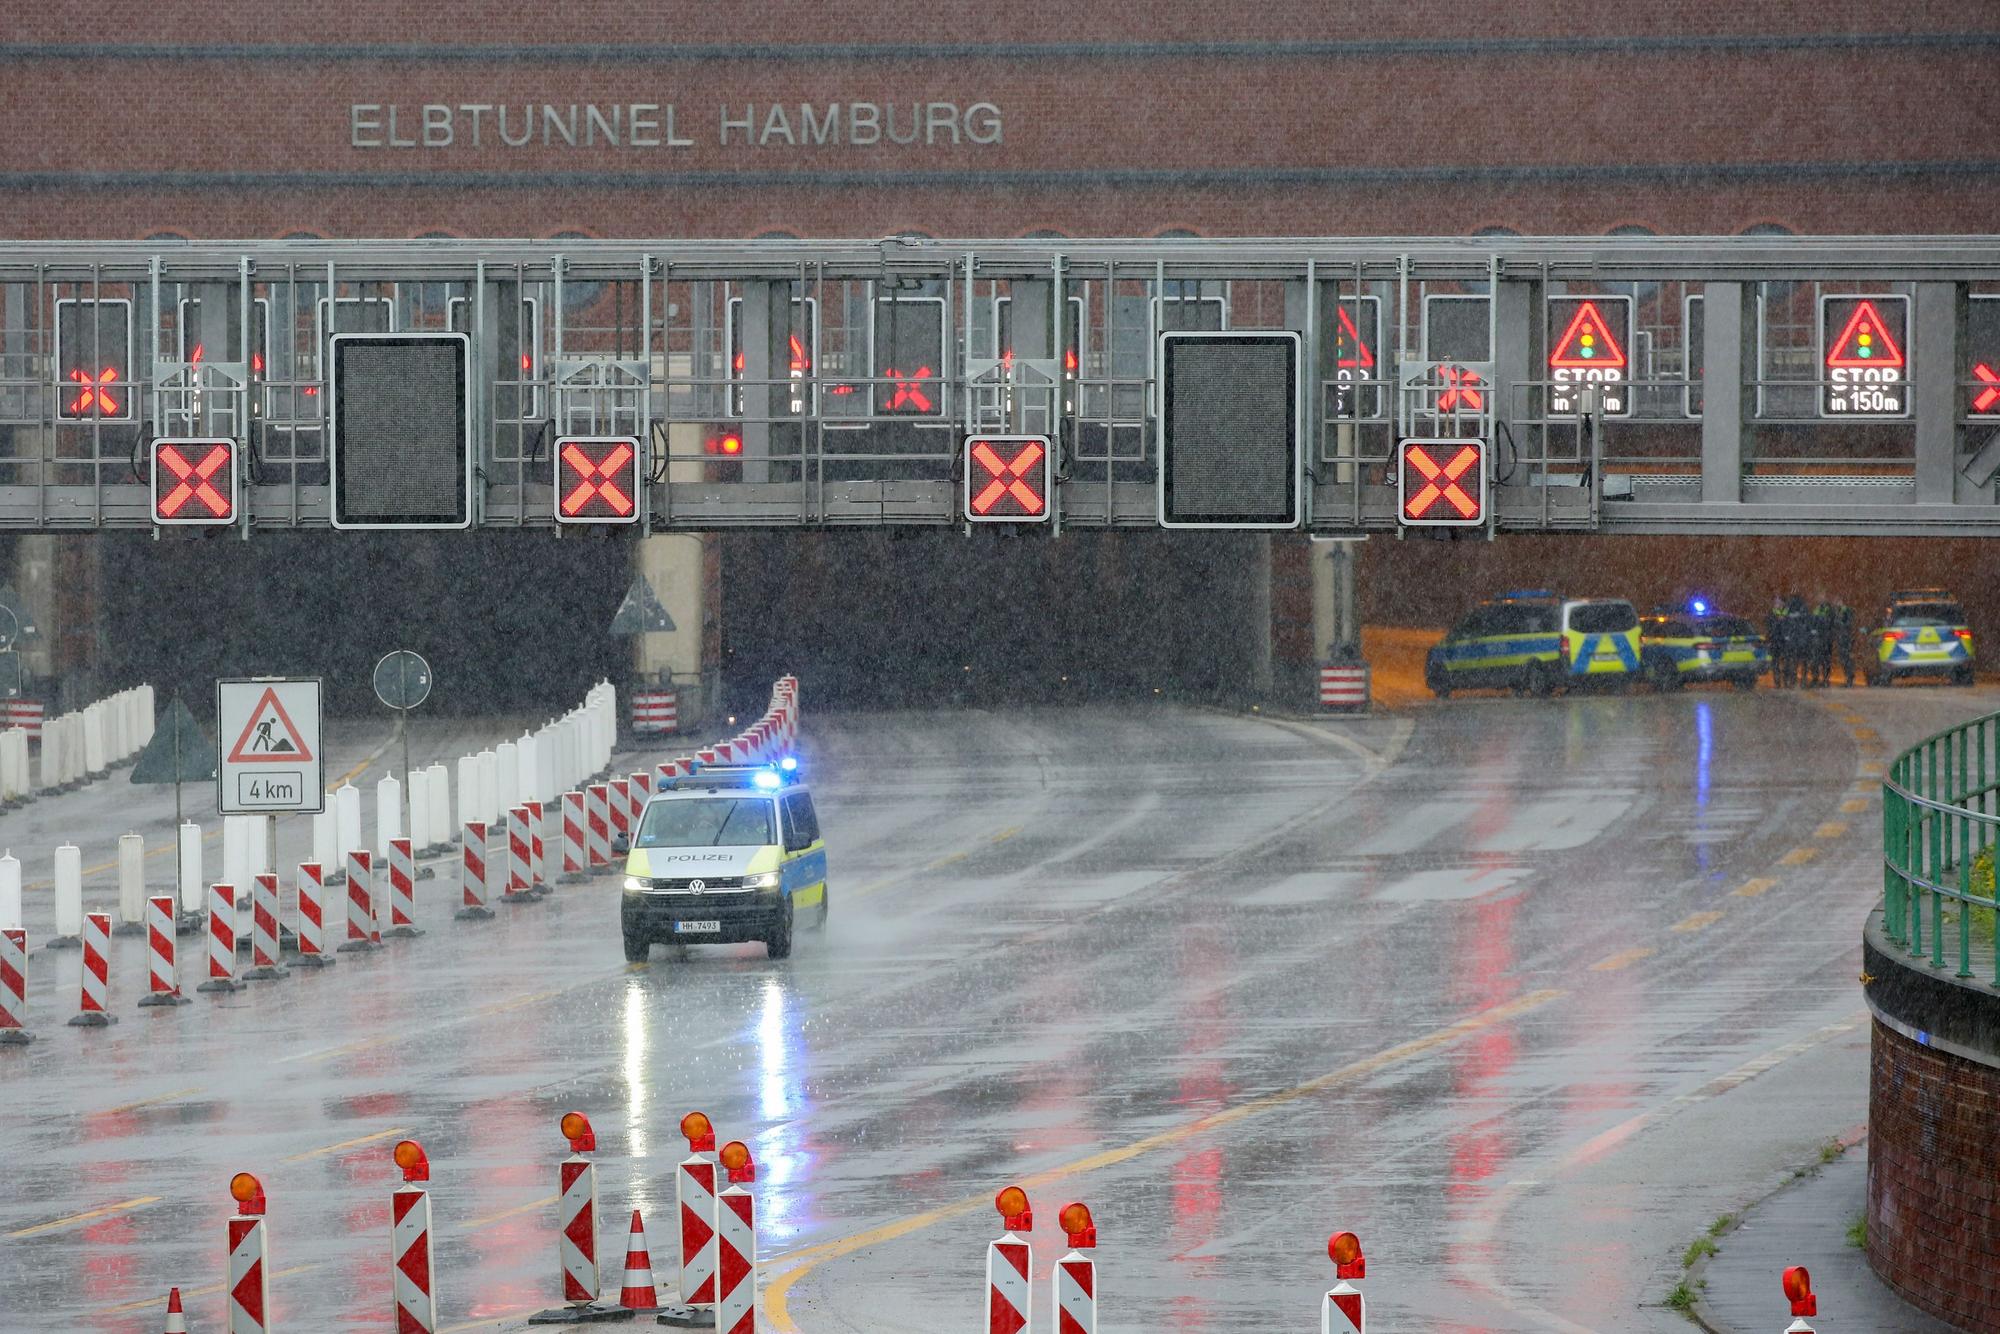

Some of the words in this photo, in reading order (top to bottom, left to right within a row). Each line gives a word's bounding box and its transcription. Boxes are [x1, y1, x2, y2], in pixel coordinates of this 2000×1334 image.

[351, 104, 694, 146] ELBTUNNEL
[720, 102, 1003, 145] HAMBURG
[1554, 368, 1621, 391] STOP
[1831, 367, 1899, 391] STOP
[1554, 392, 1570, 411] in
[1831, 392, 1847, 411] in
[1850, 391, 1899, 411] 150m
[249, 781, 260, 799] 4
[265, 780, 293, 798] km
[667, 854, 733, 862] POLIZEI
